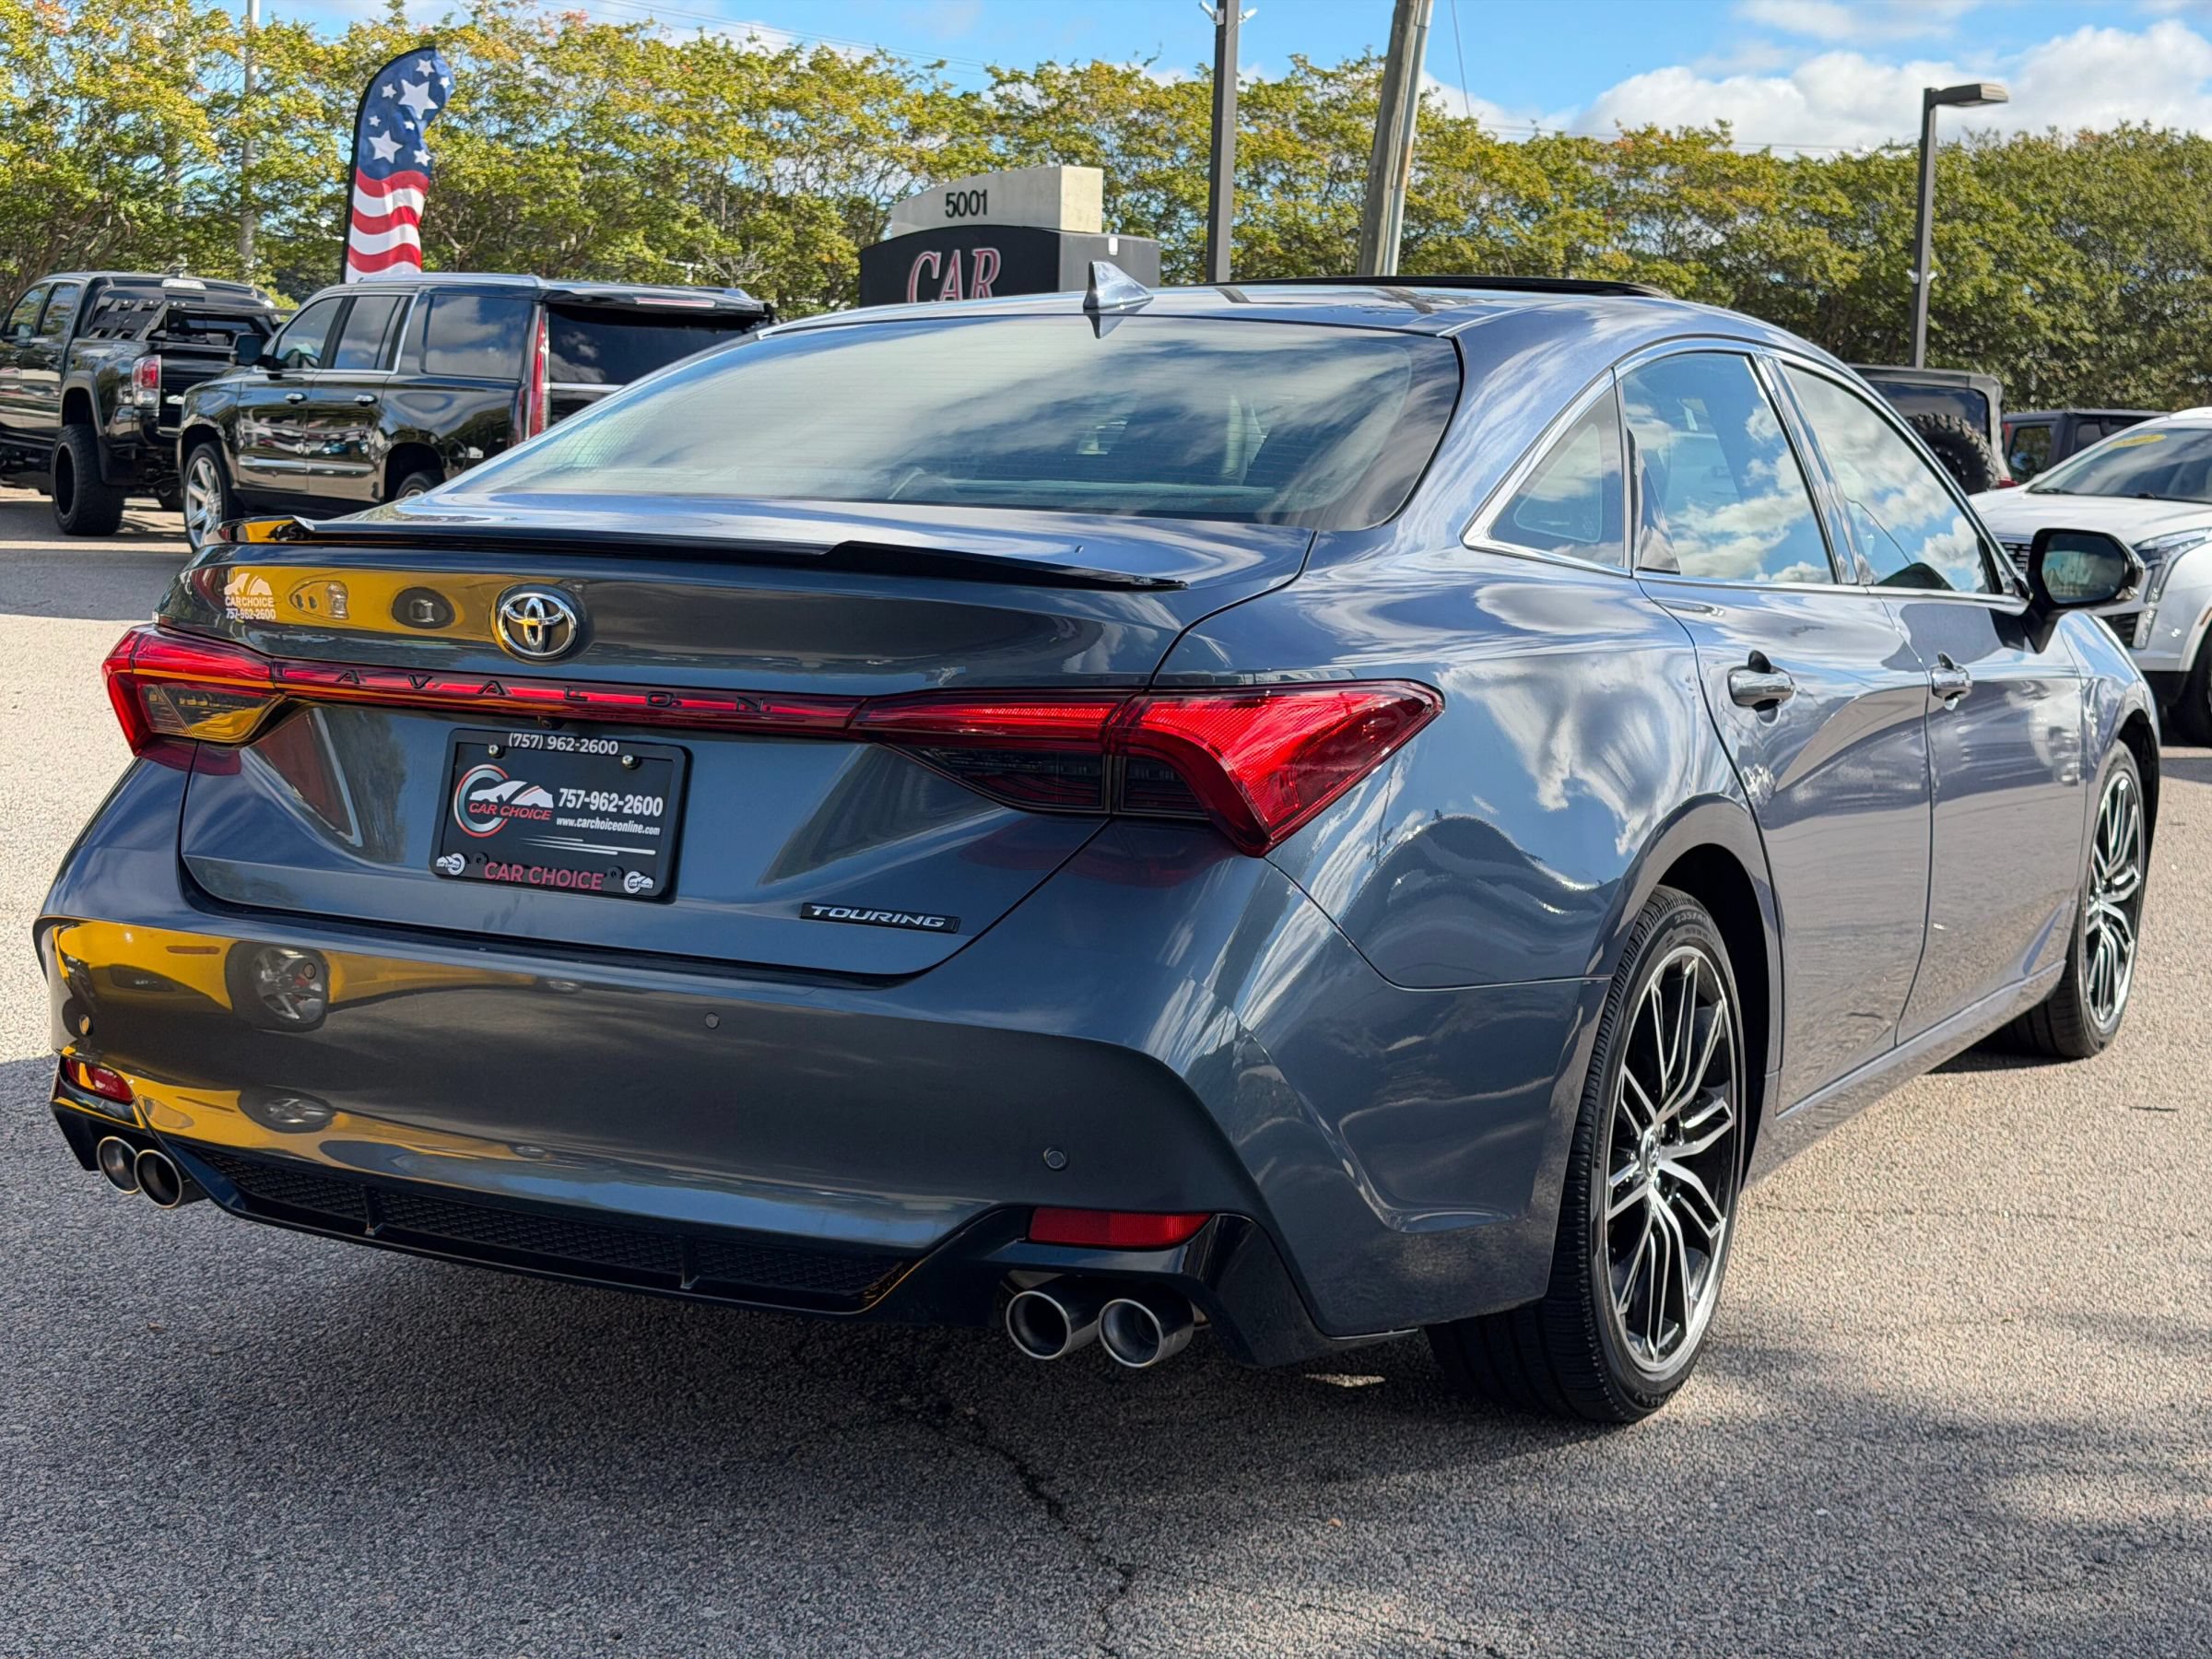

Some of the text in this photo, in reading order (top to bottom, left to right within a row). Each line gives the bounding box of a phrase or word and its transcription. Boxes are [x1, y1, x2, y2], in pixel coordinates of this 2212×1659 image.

[945, 189, 988, 218] 5001
[907, 247, 1002, 304] CAR
[226, 607, 276, 620] 757-962-2600
[335, 669, 765, 713] AVALON
[508, 732, 619, 755] (757) 962-2600
[468, 802, 553, 821] CAR CHOICE
[558, 787, 664, 817] 757-962-2600
[556, 816, 661, 836] www.carchoiceonline.com
[484, 861, 605, 890] CAR CHOICE
[811, 905, 947, 928] TOURING
